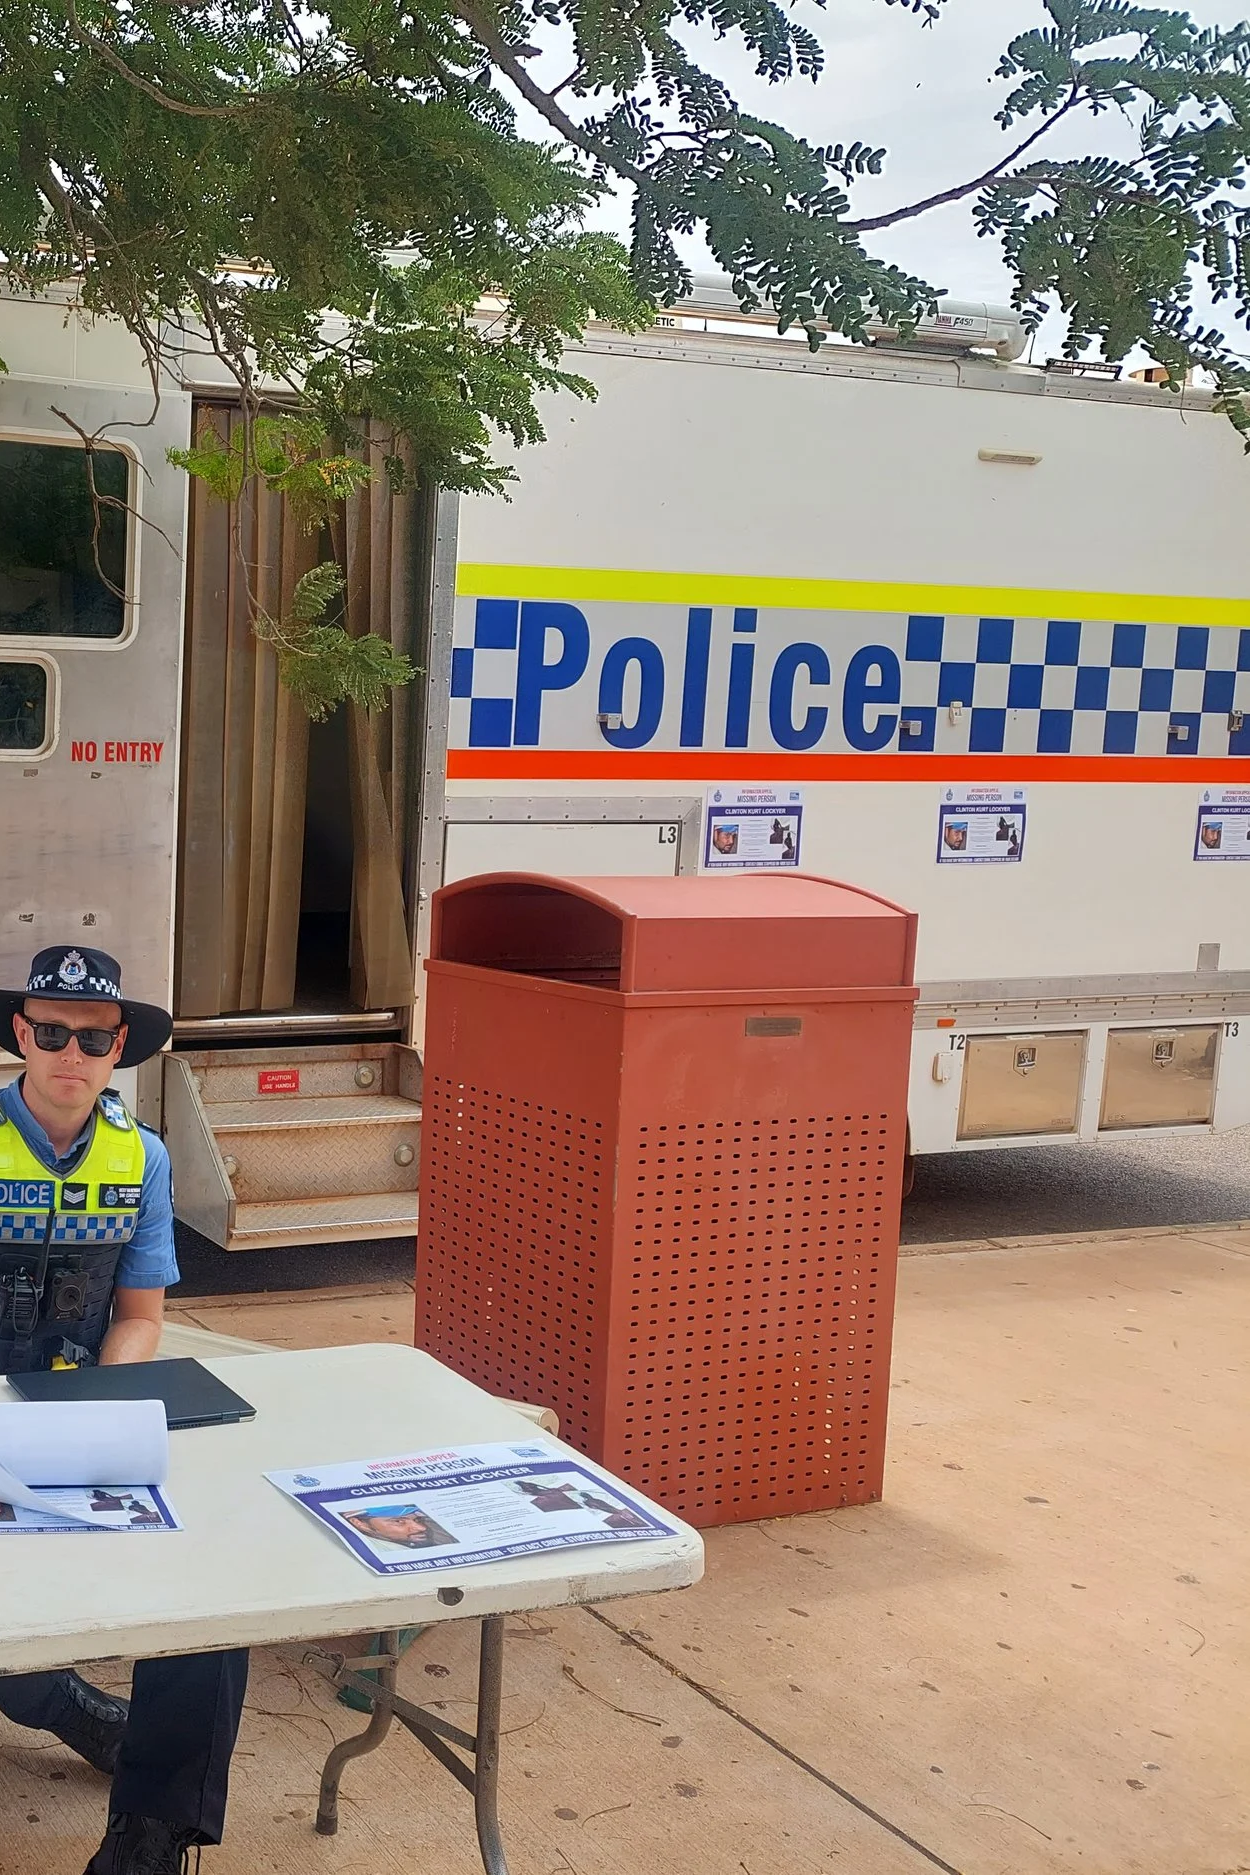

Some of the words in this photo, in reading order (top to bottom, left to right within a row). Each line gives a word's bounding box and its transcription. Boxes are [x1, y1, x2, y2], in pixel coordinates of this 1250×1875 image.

[513, 601, 901, 751] Police
[71, 741, 97, 762] NO
[104, 742, 164, 762] ENTRY
[658, 826, 677, 844] L3
[57, 982, 84, 991] POLICE
[1225, 1021, 1239, 1037] T3
[949, 1034, 965, 1050] T2
[266, 1074, 292, 1082] CAUTION
[363, 1464, 426, 1480] MISSING
[428, 1456, 486, 1473] PERSON
[367, 1457, 425, 1471] INFORMATION
[426, 1452, 462, 1464] APPEAL
[350, 1482, 417, 1496] CLINTON
[419, 1477, 460, 1489] KURT
[461, 1466, 535, 1483] LOCKYER
[385, 1565, 395, 1573] IF
[395, 1563, 414, 1572] YOU
[413, 1560, 436, 1570] HAVE
[433, 1558, 451, 1567] ANY
[449, 1549, 504, 1565] INFORMATION
[507, 1541, 542, 1553] CONTACT
[542, 1537, 568, 1548] CRIME
[567, 1532, 603, 1544] STOPPERS
